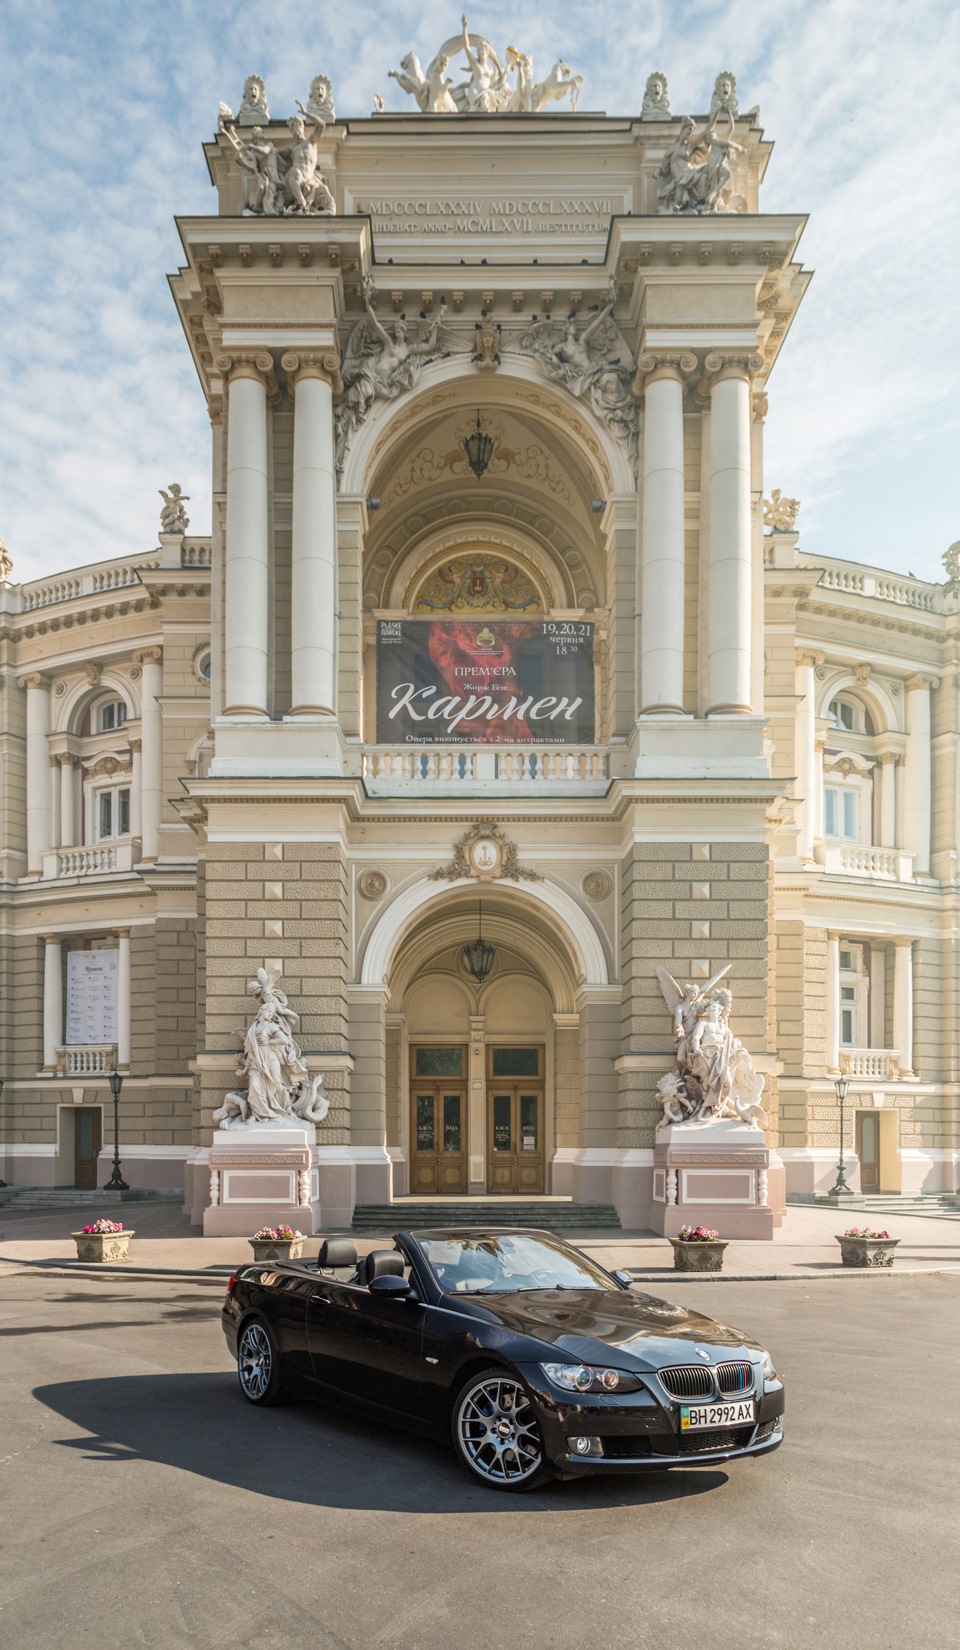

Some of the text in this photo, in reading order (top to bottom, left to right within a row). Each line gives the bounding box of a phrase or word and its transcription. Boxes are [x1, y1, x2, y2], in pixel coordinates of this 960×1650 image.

[368, 200, 612, 215] MDCCCLXXXIV MDCCCLXXXVII
[455, 219, 532, 233] MCMLXVII
[550, 636, 584, 646] червня
[463, 683, 490, 692] Жорж
[388, 682, 583, 734] Кармен
[405, 734, 433, 744] Опера
[690, 1404, 751, 1425] BH 2992 AX
